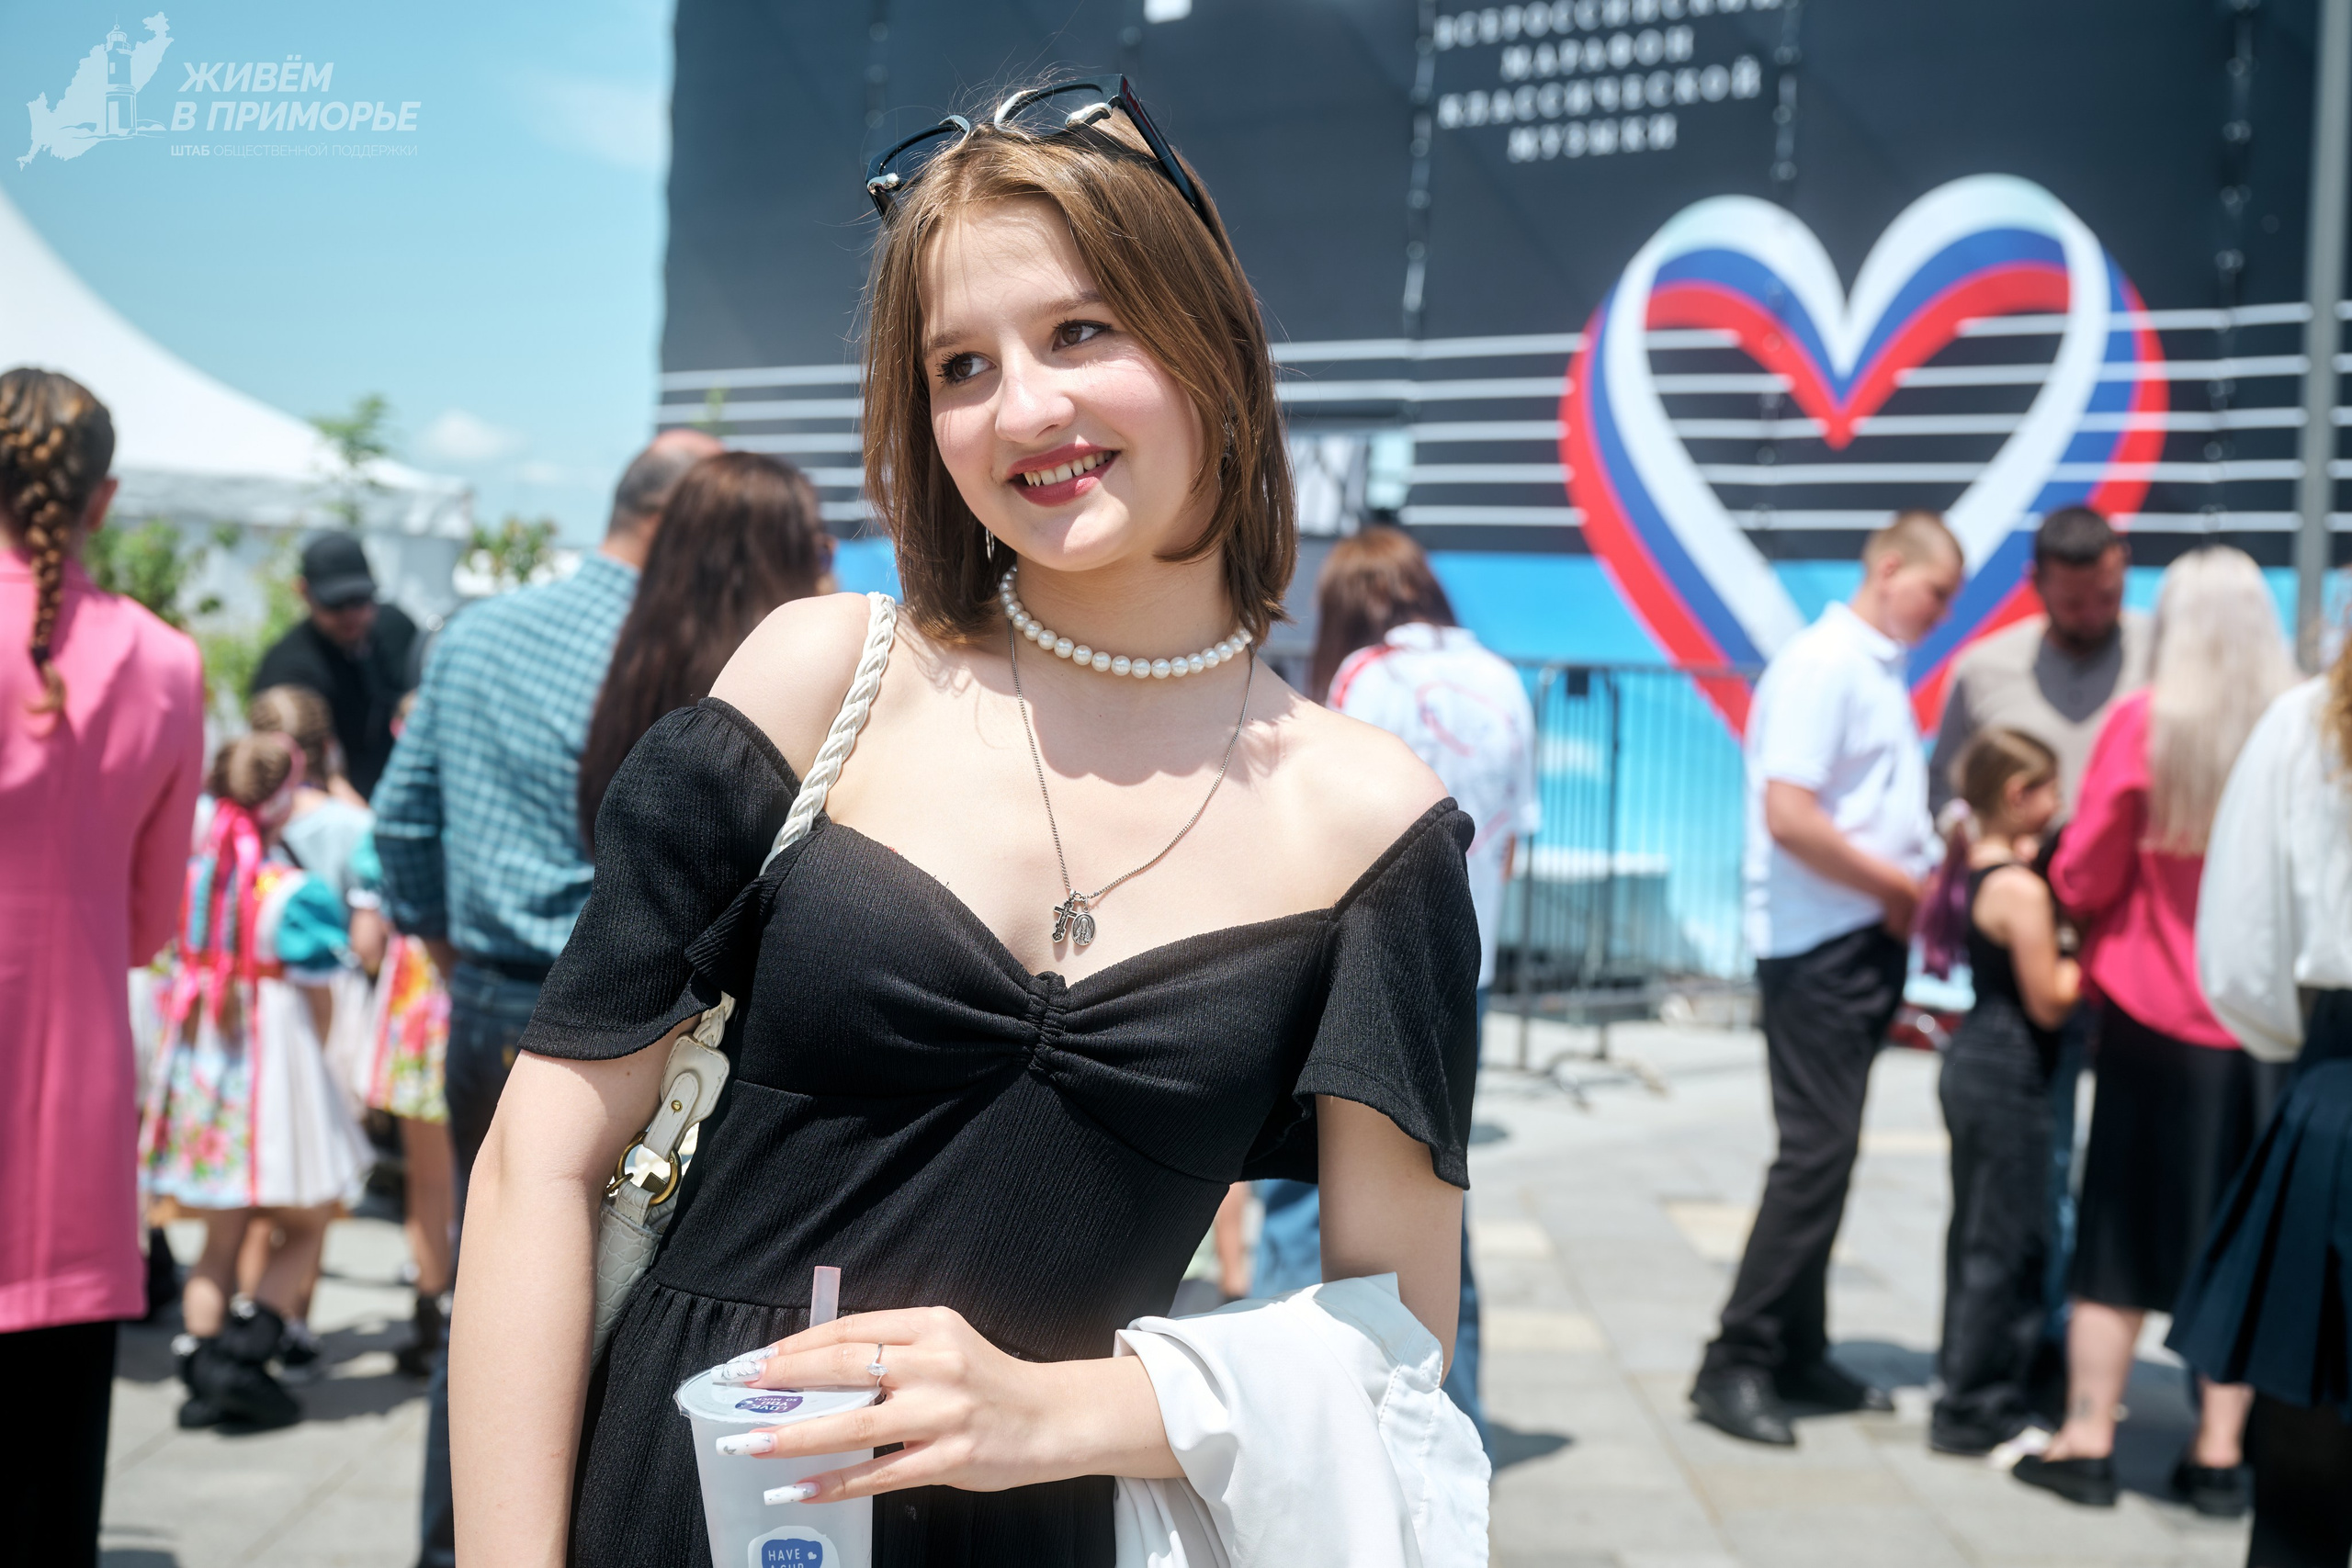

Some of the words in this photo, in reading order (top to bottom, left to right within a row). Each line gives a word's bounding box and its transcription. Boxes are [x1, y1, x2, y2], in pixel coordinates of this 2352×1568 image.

[1500, 25, 1694, 82] МАРАФОН
[1438, 54, 1761, 130] КЛАССИЧЕСКОЙ
[1507, 112, 1678, 164] МУЗЫКИ
[768, 1548, 800, 1562] HAVE
